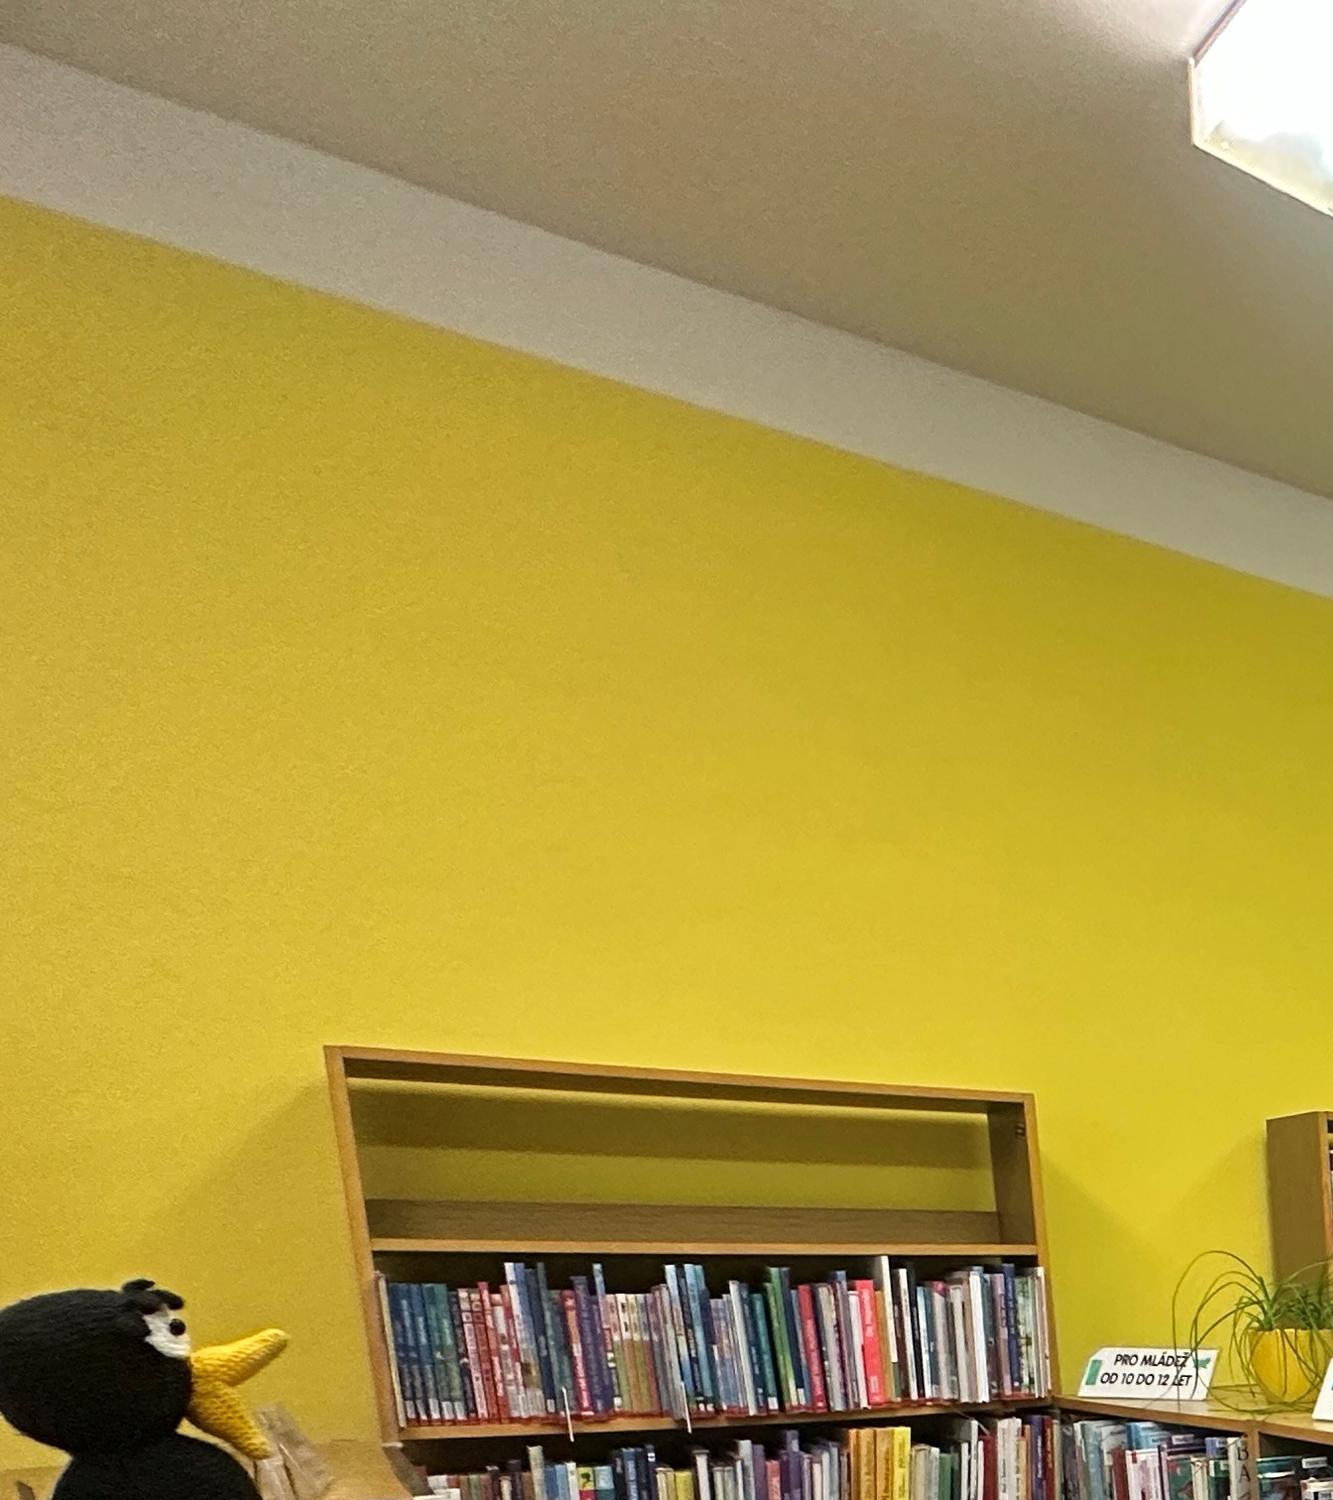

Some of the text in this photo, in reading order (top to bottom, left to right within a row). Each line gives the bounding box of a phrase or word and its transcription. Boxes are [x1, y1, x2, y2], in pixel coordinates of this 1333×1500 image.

[1114, 1351, 1190, 1369] PRO MLÁDEŽ
[1100, 1370, 1192, 1388] OD 10 DO 12 LET
